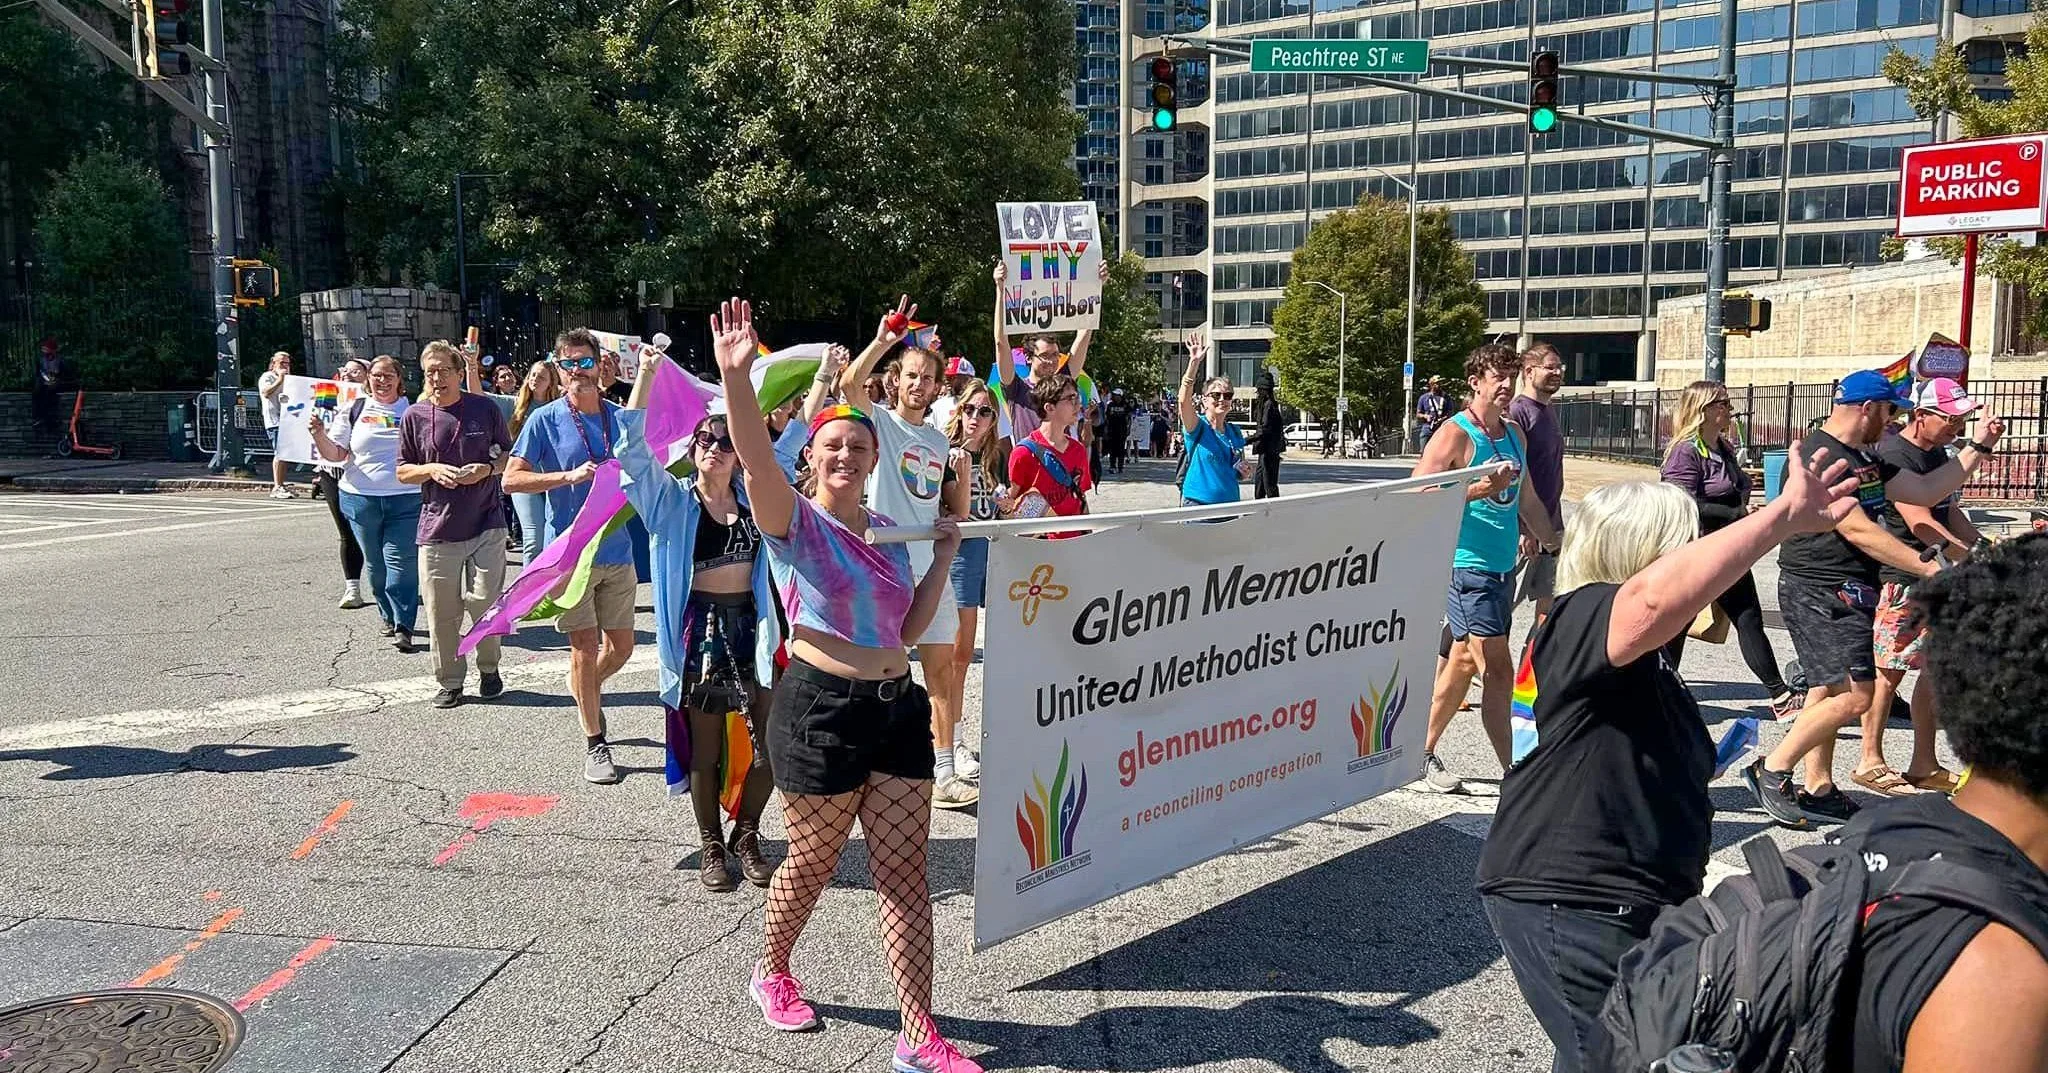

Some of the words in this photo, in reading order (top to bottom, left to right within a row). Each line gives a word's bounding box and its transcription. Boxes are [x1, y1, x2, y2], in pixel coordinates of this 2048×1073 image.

[1271, 46, 1359, 67] Peachtree
[1367, 47, 1388, 67] ST
[1391, 52, 1405, 64] NE
[1920, 160, 2003, 183] PUBLIC
[2023, 146, 2035, 159] P
[1919, 179, 2020, 203] PARKING
[1001, 204, 1094, 241] LOVE
[1959, 216, 1992, 224] LEGACY
[1008, 242, 1089, 281] THY
[1004, 281, 1101, 329] Neighbor
[1072, 585, 1191, 645] Glenn
[1202, 540, 1385, 616] Memorial
[1036, 665, 1144, 727] United
[1149, 631, 1298, 698] Methodist
[1305, 609, 1406, 657] Church
[1118, 698, 1317, 787] glennumc.org
[1121, 816, 1129, 831] a
[1136, 782, 1223, 826] reconciling
[1229, 751, 1322, 793] congregation
